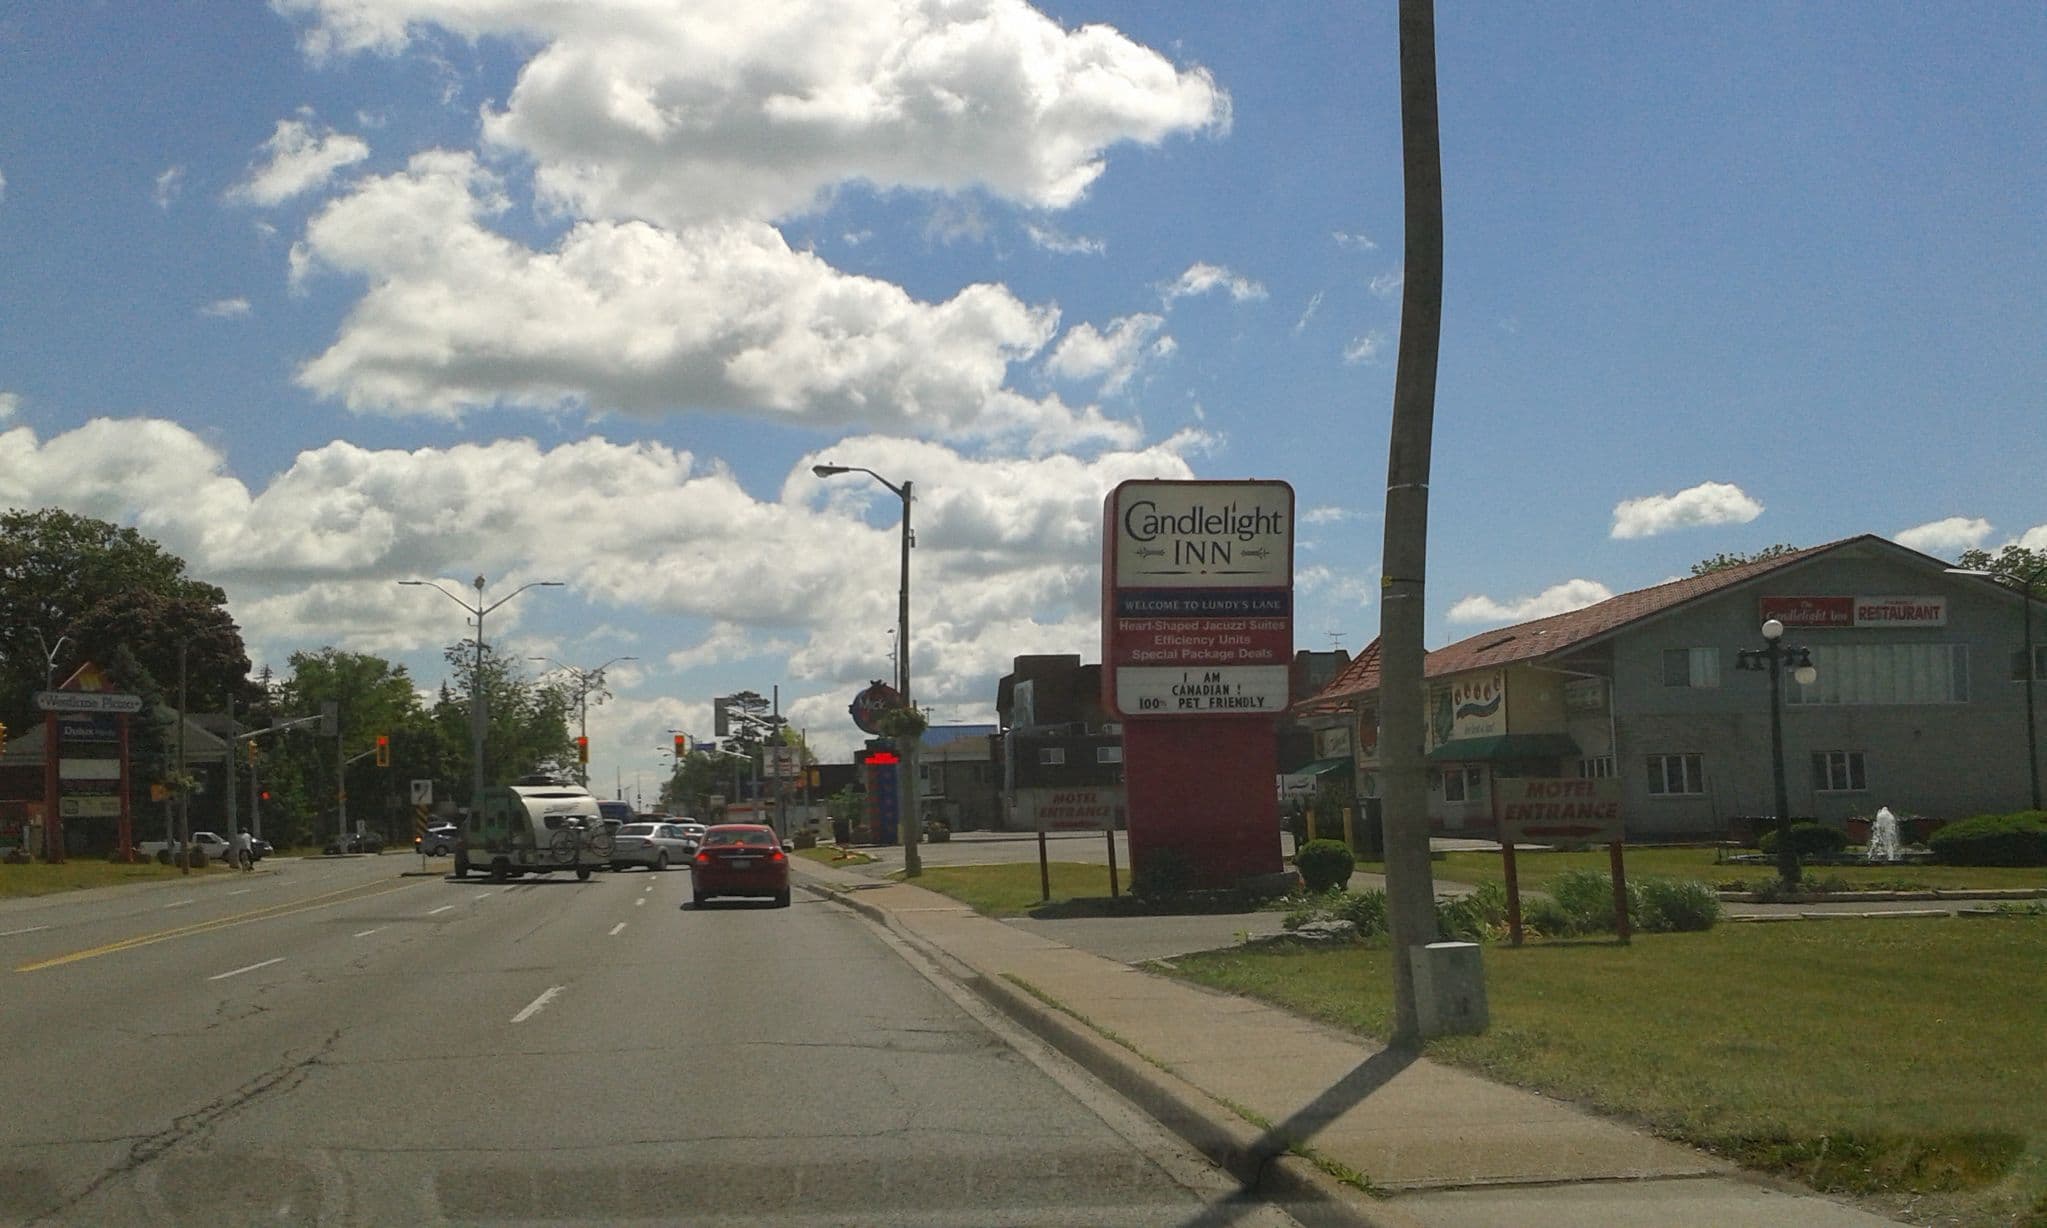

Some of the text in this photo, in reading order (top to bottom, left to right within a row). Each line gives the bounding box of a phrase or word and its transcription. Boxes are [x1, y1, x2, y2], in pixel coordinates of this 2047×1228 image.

[1125, 500, 1283, 541] Candlelight
[1175, 540, 1231, 565] INN
[1125, 600, 1280, 610] WELCOME TO LUNDY'S LANE
[1859, 605, 1941, 621] RESTAURANT
[1202, 620, 1246, 631] Jacuzzi
[1250, 619, 1285, 630] Suites
[1154, 634, 1250, 647] Efficiency Units
[1132, 648, 1272, 662] Special Package Deals
[1183, 672, 1221, 683] I AM
[1171, 684, 1230, 696] CANADIAN
[1178, 697, 1200, 709] PET
[1209, 697, 1265, 709] FRIENDLY
[1526, 781, 1595, 798] MOTEL
[1053, 792, 1097, 804] MOTEL
[1040, 805, 1110, 818] ENTRANCE
[1504, 801, 1619, 819] ENTRANCE
